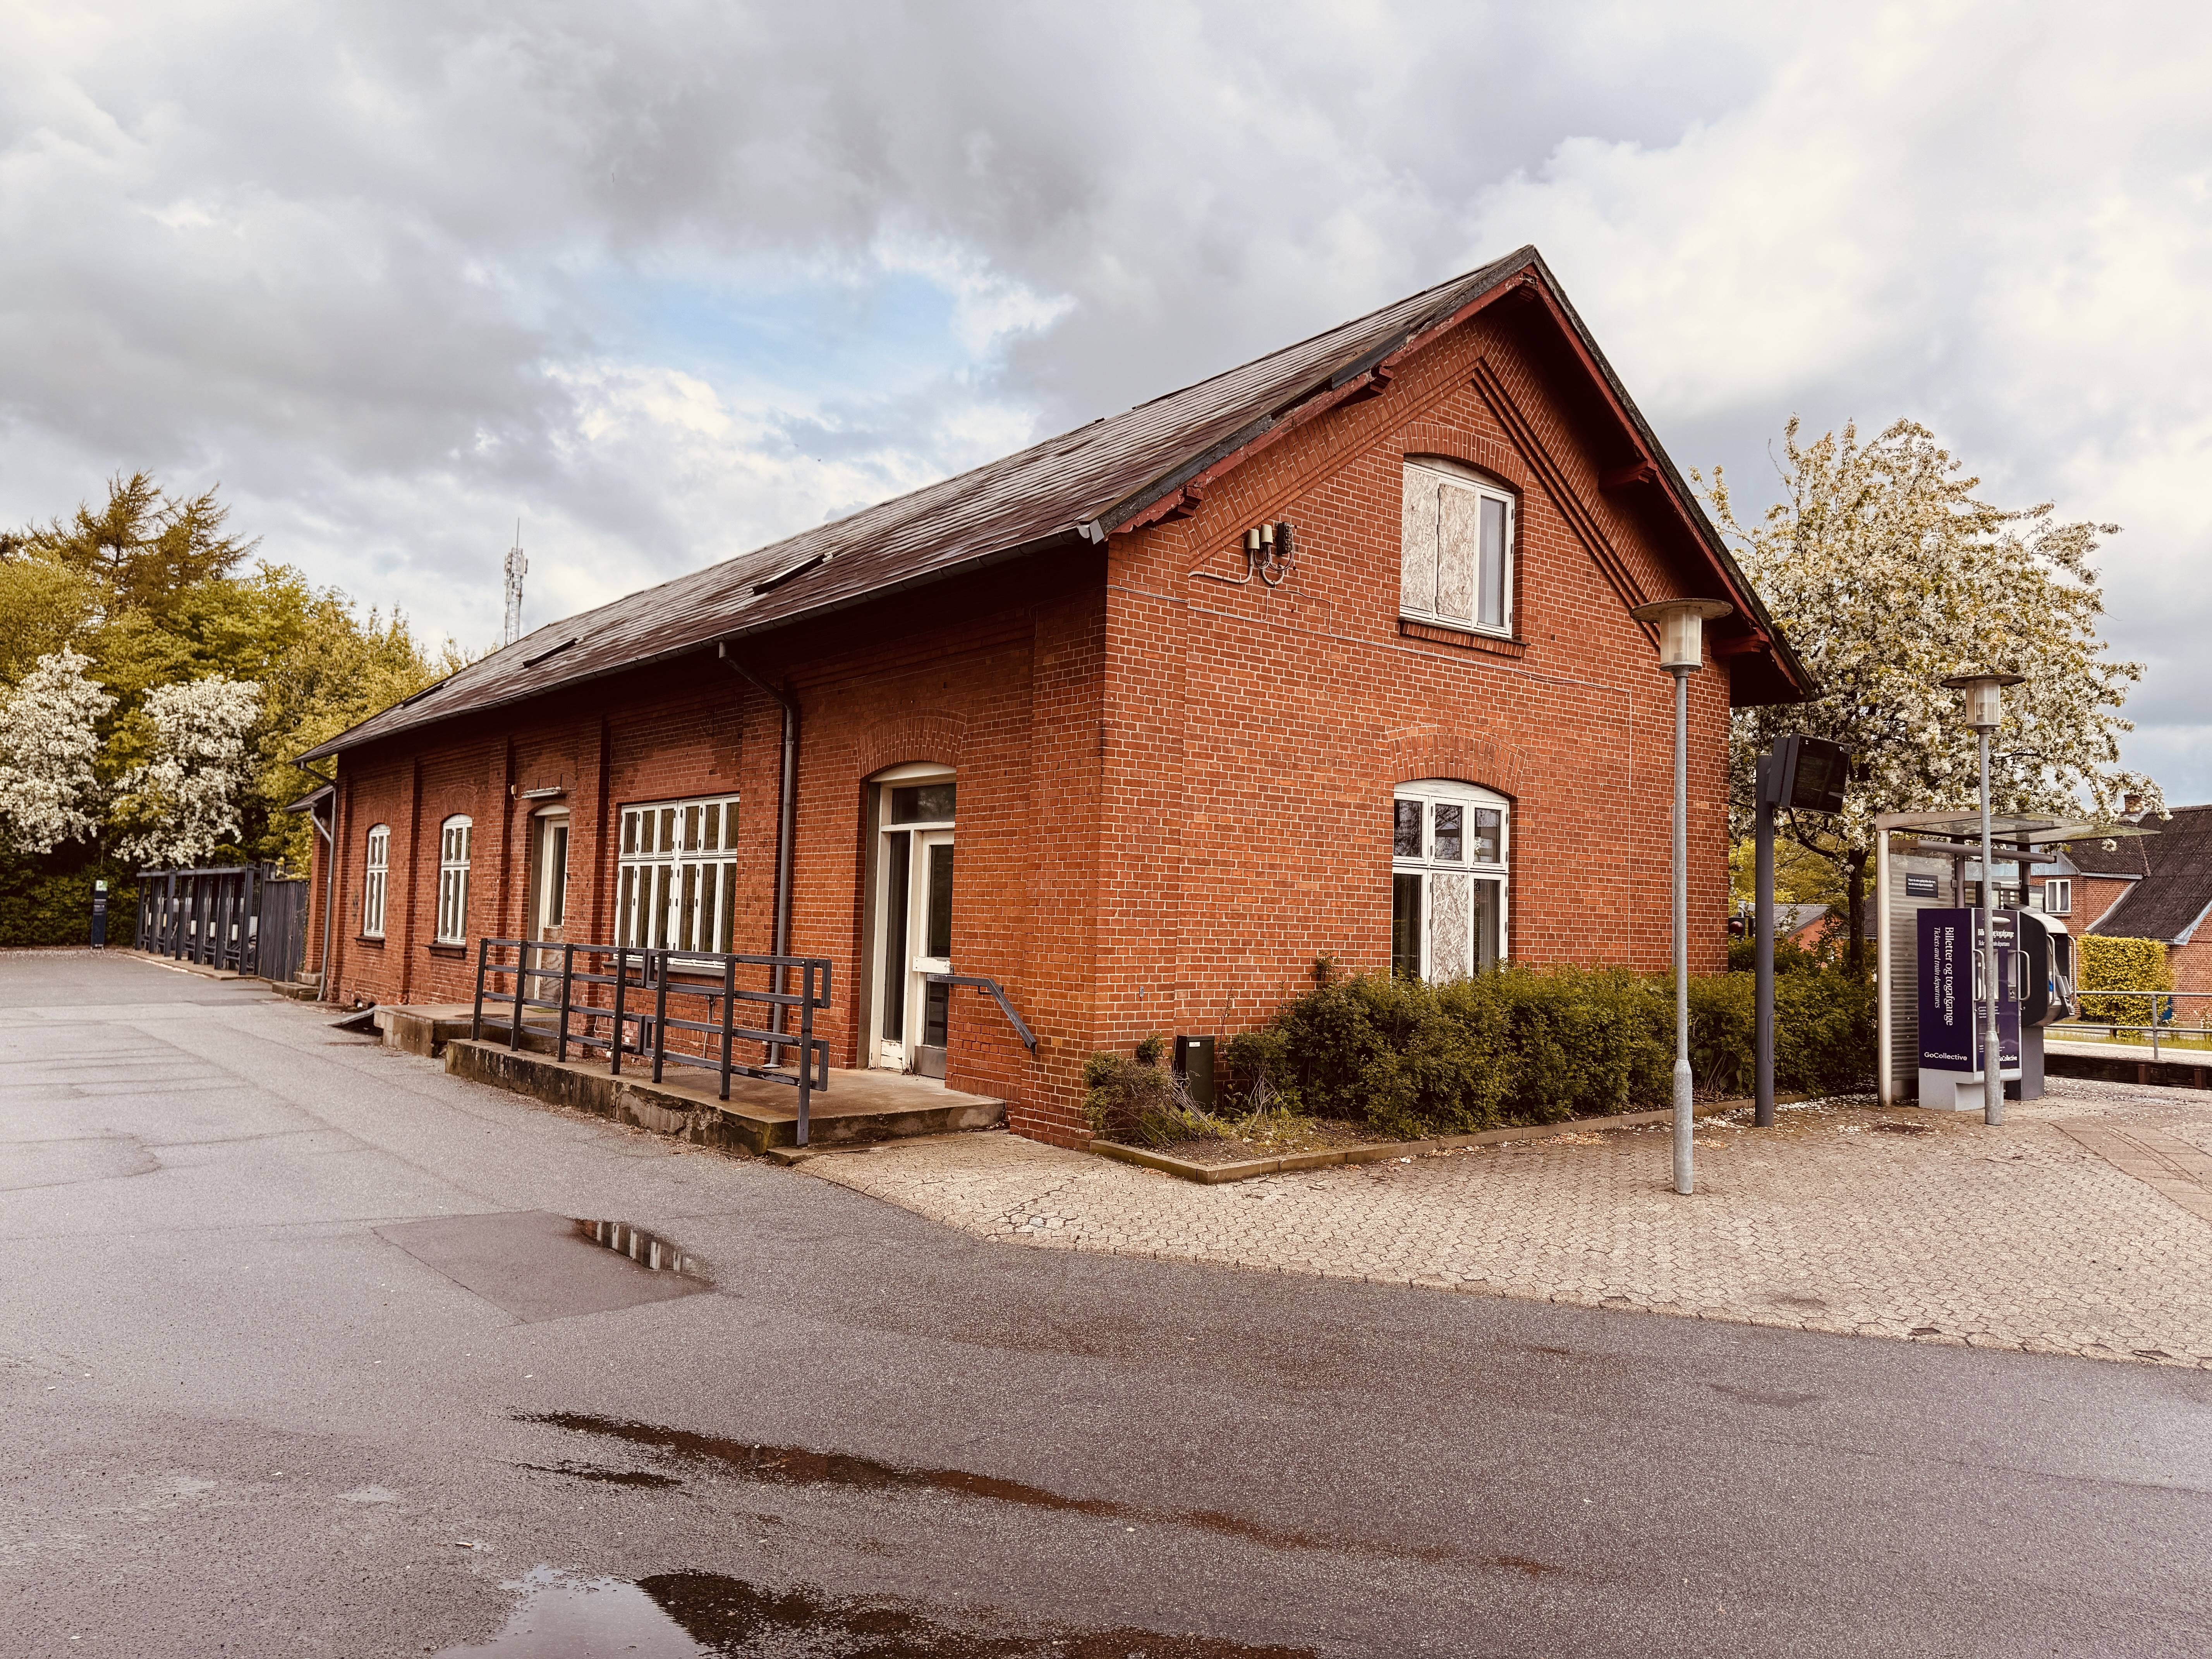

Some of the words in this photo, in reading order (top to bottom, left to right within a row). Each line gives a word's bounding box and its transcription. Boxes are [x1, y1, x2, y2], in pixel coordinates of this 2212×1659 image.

[1945, 927, 1954, 962] Billetter
[1944, 963, 1953, 975] og
[1944, 977, 1955, 1026] togafgange
[1924, 1052, 1967, 1061] GoCollective
